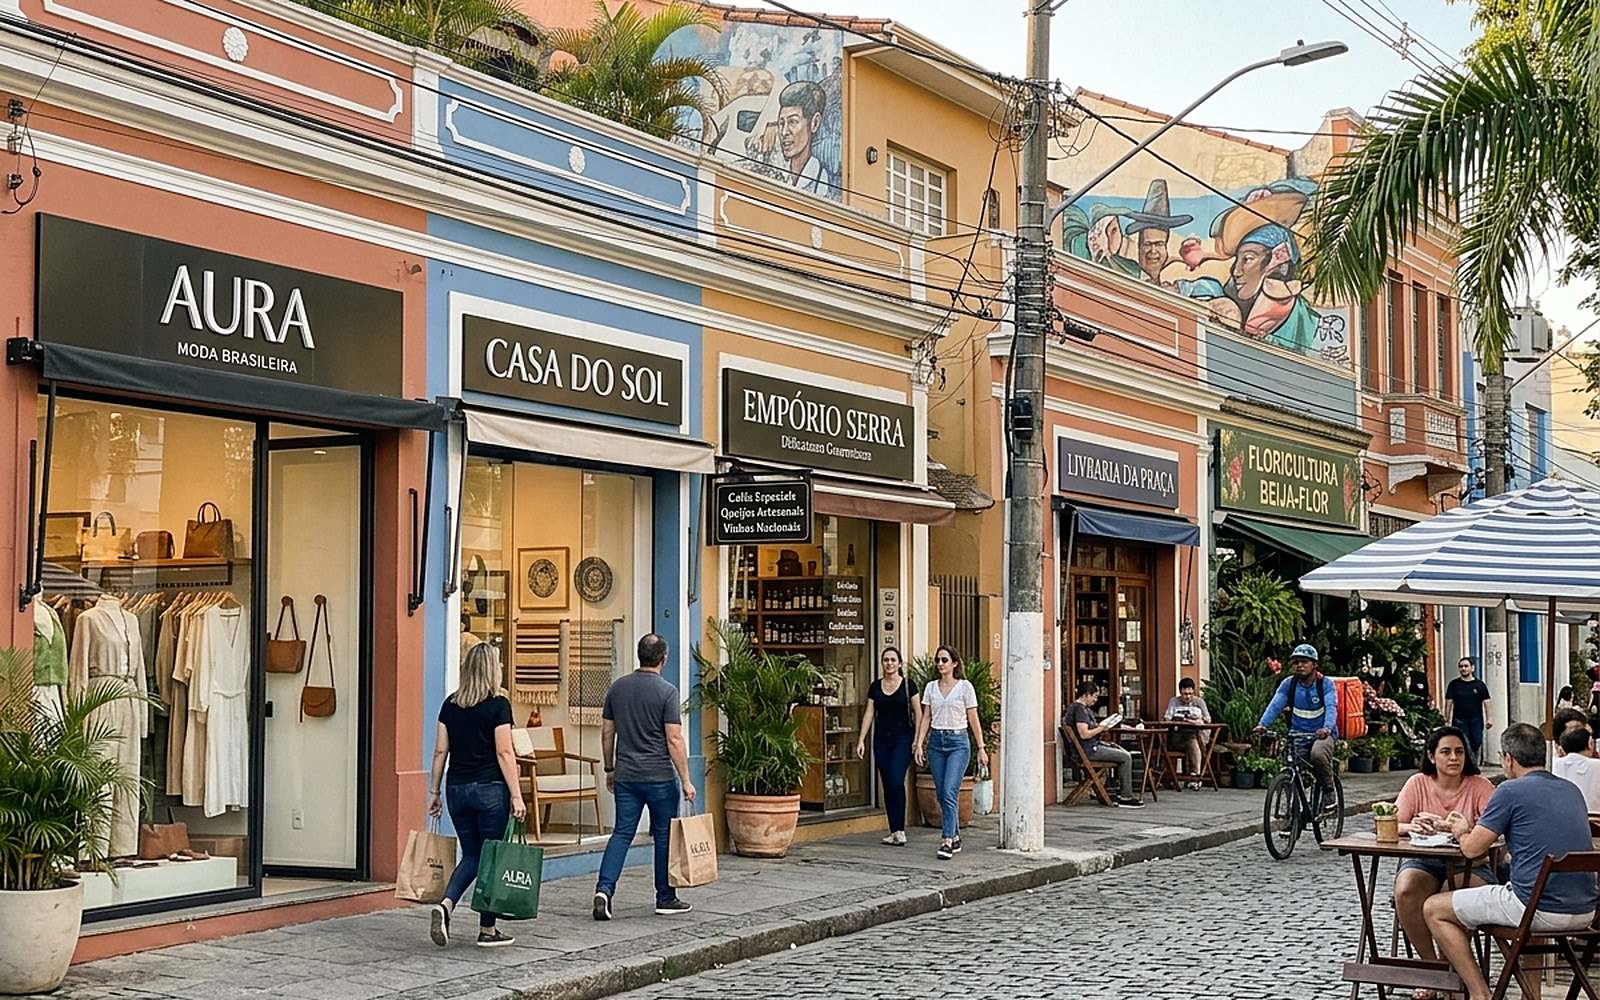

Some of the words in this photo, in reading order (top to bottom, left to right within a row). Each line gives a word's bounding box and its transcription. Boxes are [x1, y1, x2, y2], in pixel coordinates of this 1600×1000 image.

[160, 264, 316, 349] AURA
[177, 341, 218, 361] MODA
[222, 349, 298, 374] BRASILEIRA
[486, 338, 563, 388] CASA
[571, 353, 615, 396] DO
[621, 364, 669, 406] SOL
[743, 389, 842, 437] EMPÓRIO
[846, 409, 905, 448] SERRA
[1123, 464, 1139, 488] DA
[1141, 467, 1175, 497] PRAÇA
[1248, 444, 1339, 487] FLORICULTURA
